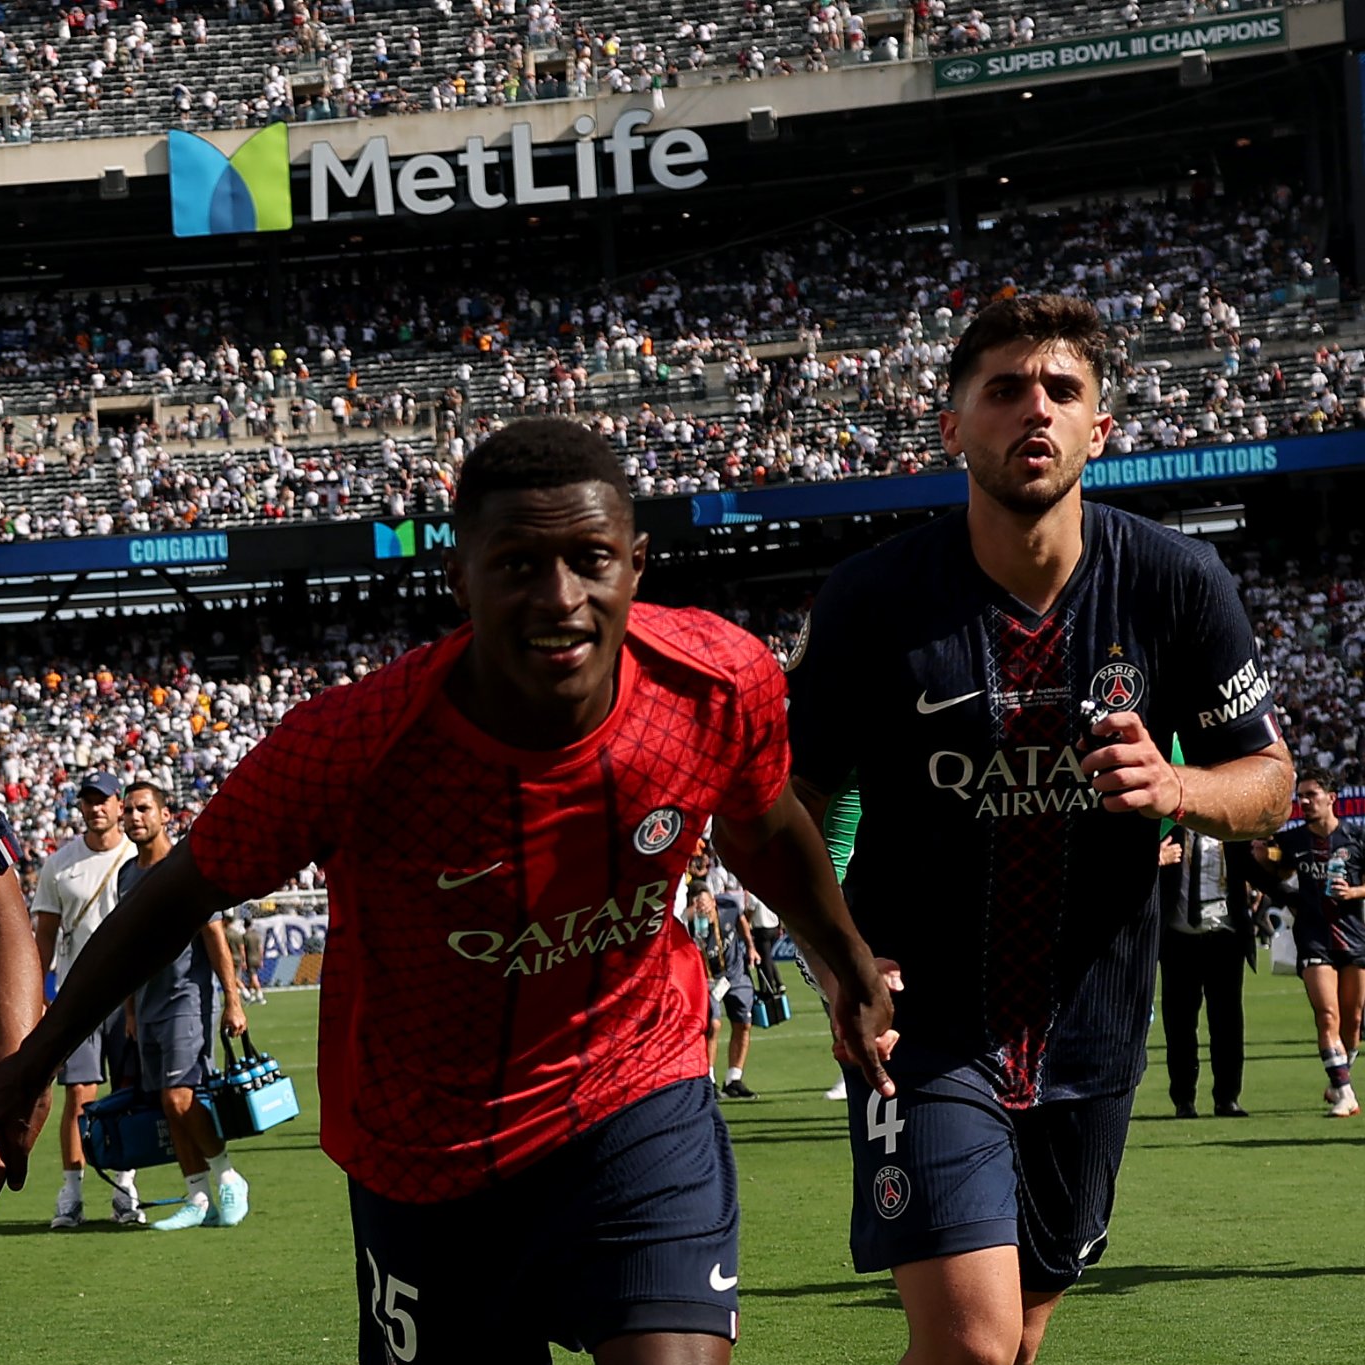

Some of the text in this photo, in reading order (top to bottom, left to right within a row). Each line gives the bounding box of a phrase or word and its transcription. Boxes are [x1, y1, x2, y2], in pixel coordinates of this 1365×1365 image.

[987, 17, 1282, 76] SUPER BOWL III CHAMPIONS
[311, 107, 710, 222] MetLife
[1081, 445, 1278, 488] CONGRATULATIONS
[1099, 666, 1137, 681] PARIS
[1218, 659, 1257, 700] VISIT
[447, 880, 668, 963] QATAR
[503, 911, 664, 977] AIRWAYS
[866, 1088, 905, 1155] 4
